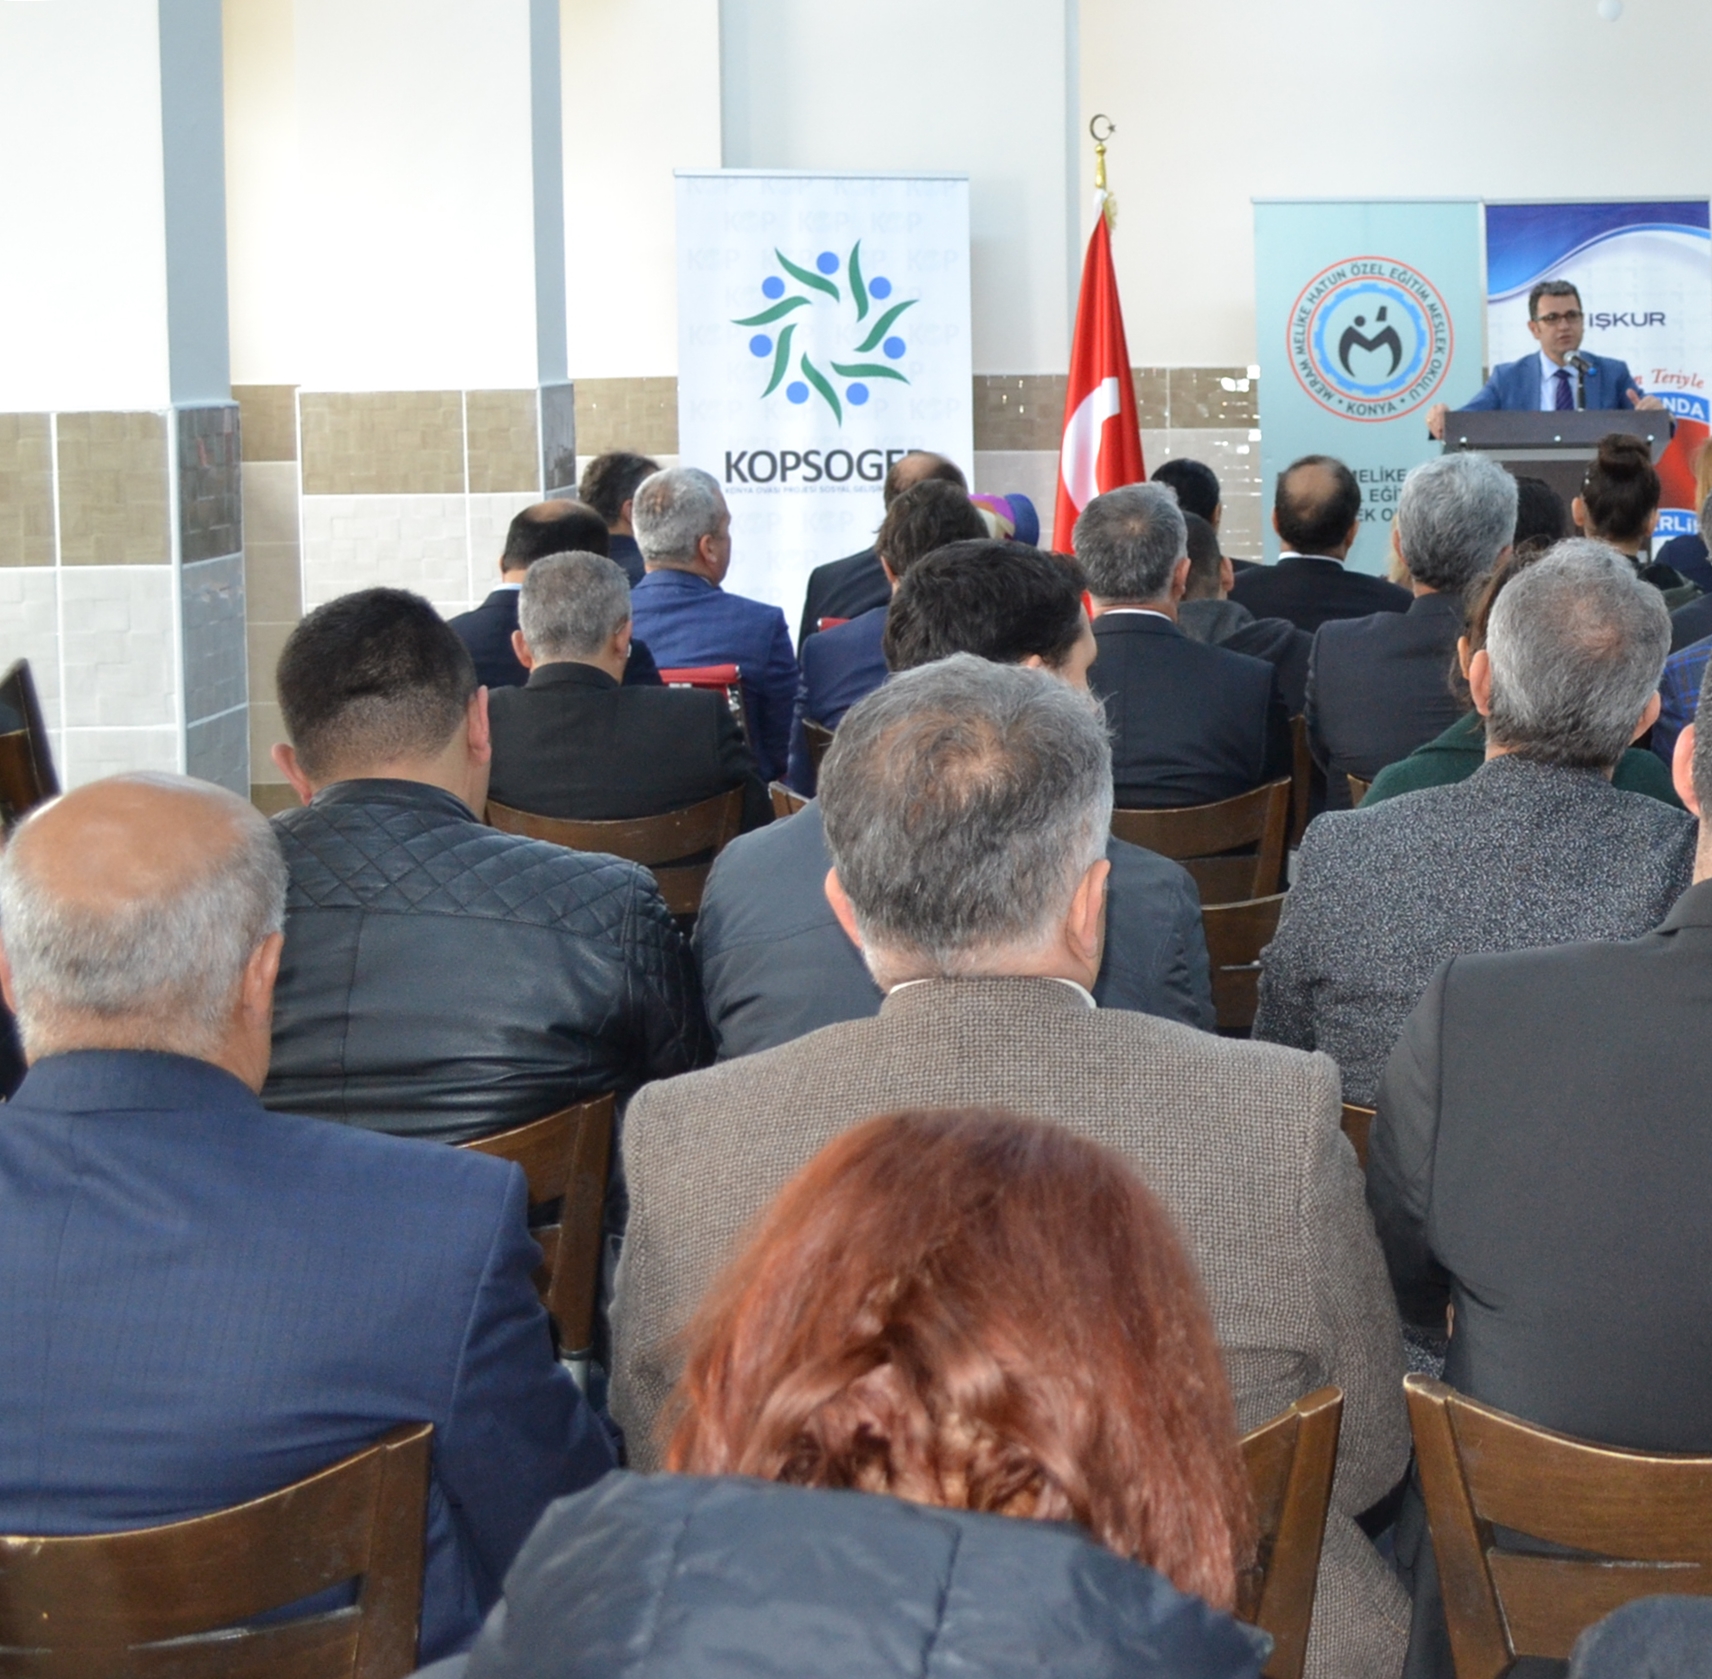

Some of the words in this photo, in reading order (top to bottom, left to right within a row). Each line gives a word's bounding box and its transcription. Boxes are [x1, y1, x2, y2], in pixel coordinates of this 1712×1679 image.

[1350, 262, 1385, 276] ÖZEL
[1389, 267, 1430, 300] EĞİTİM
[1306, 269, 1347, 304] HATUN
[1294, 306, 1311, 355] MELİKE
[1426, 302, 1446, 354] MESLEK
[1299, 359, 1335, 401] MERAM
[1408, 359, 1442, 400] OKULU
[1651, 368, 1705, 389] Teriyle
[1346, 401, 1398, 416] KONYA
[1353, 466, 1406, 483] ELİKE
